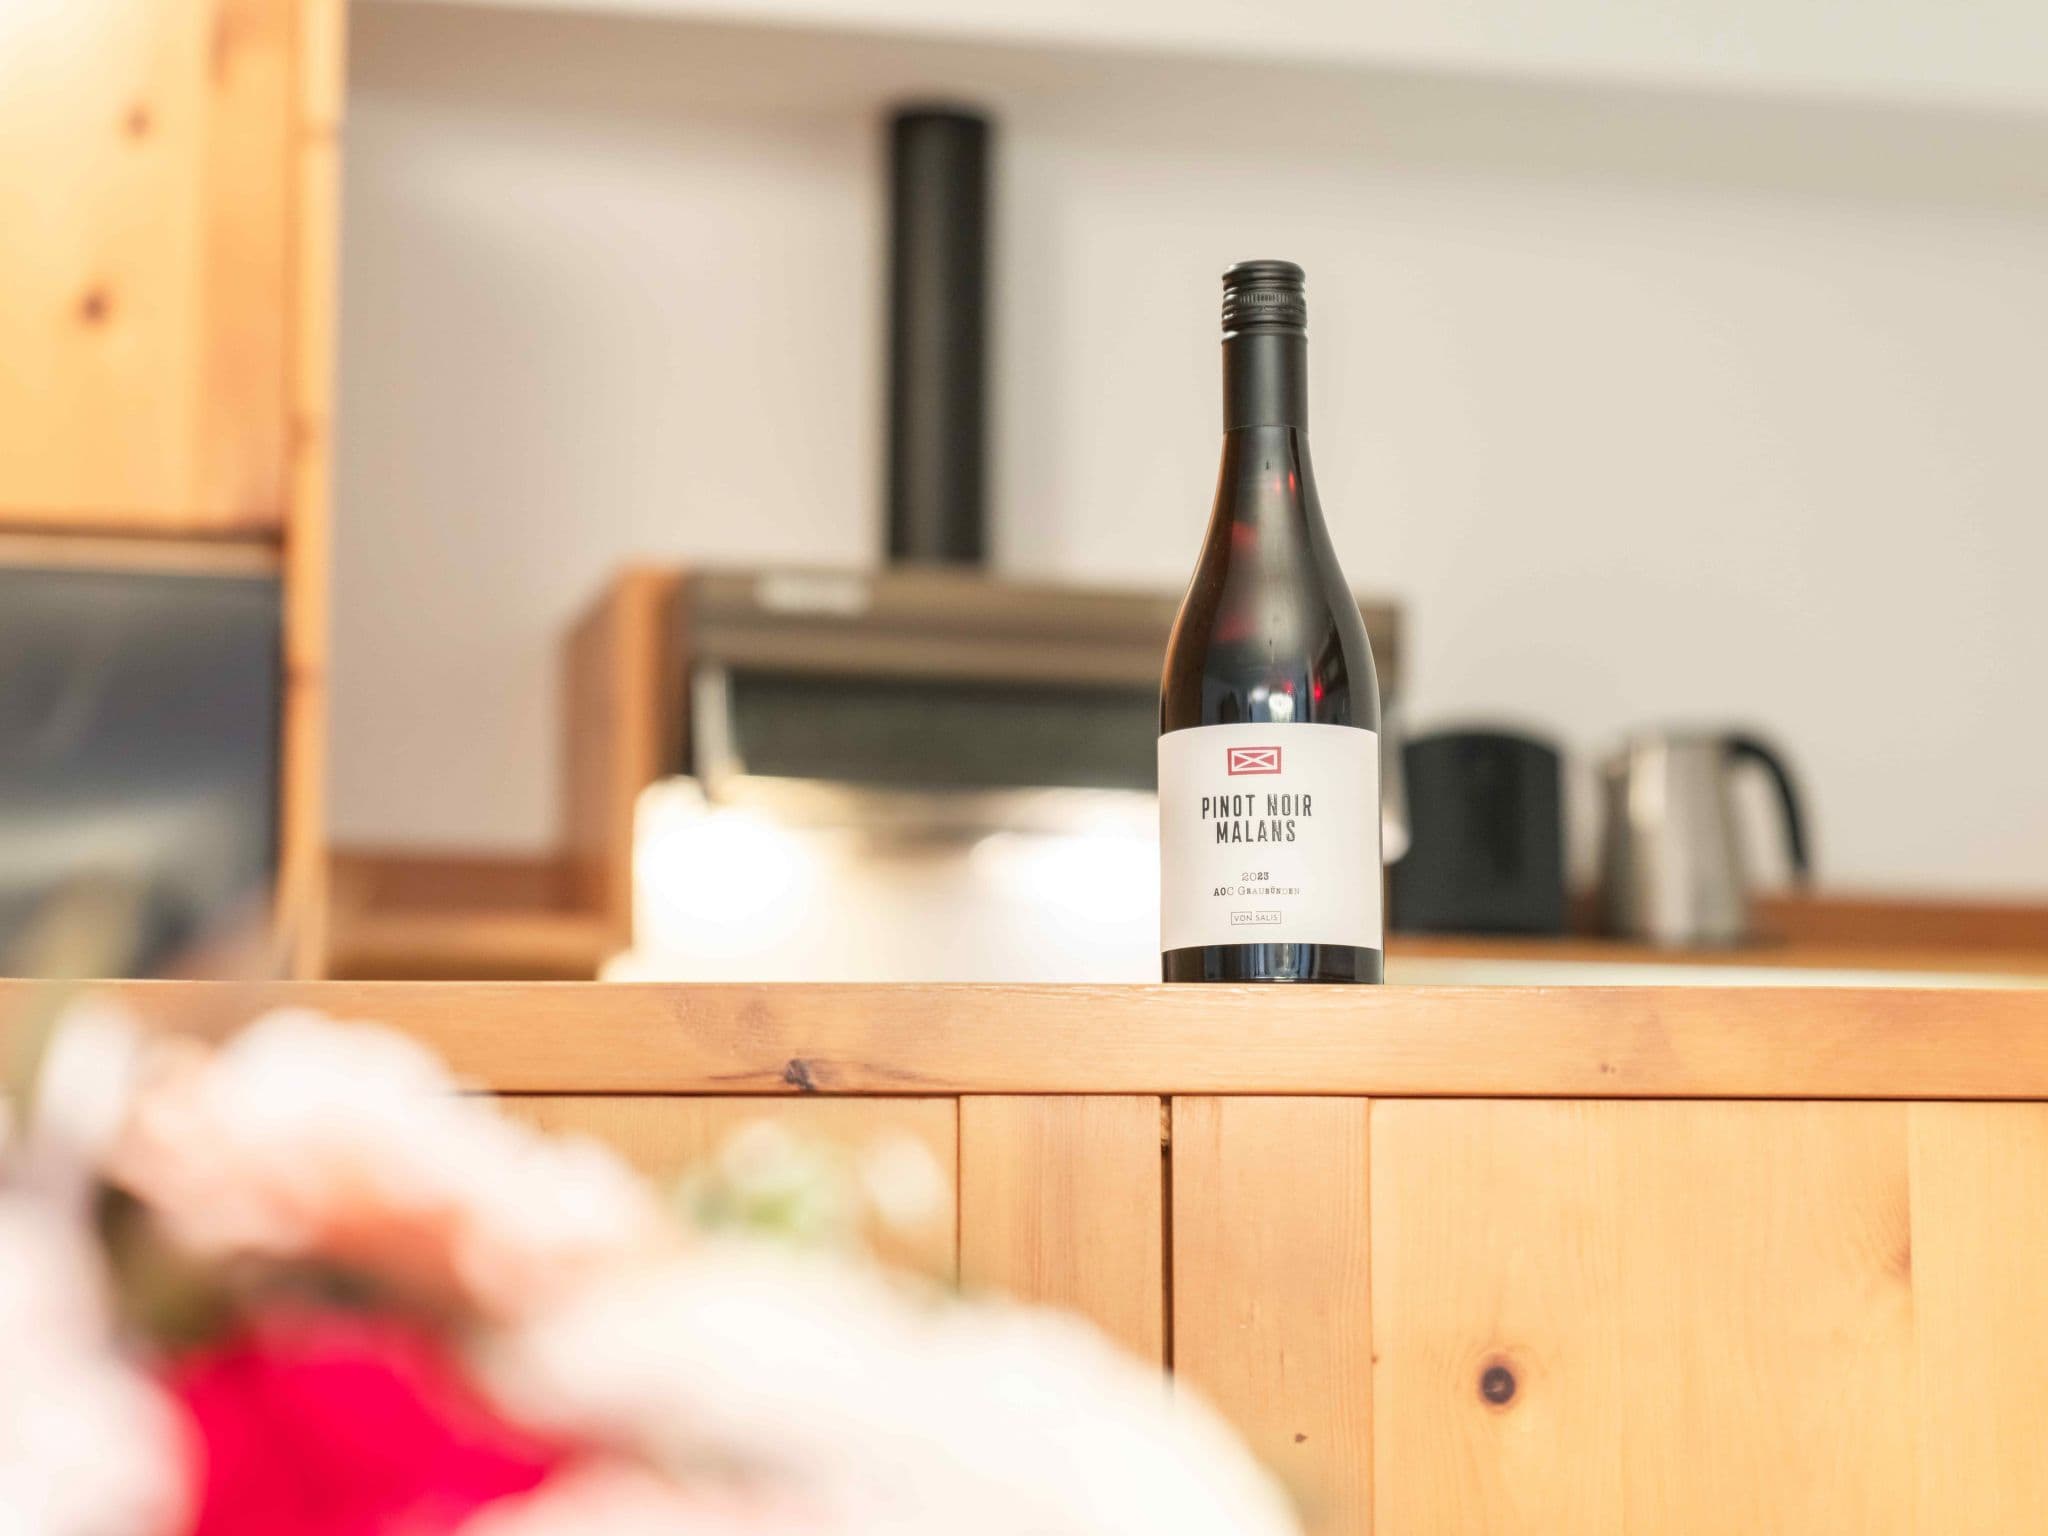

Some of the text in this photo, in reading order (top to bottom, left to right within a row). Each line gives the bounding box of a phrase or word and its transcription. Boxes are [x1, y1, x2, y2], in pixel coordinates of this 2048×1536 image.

[1202, 794, 1312, 820] PINOT NOIR
[1216, 819, 1296, 844] MALANS
[1241, 871, 1270, 882] 2023
[1213, 886, 1234, 897] AOC
[1233, 913, 1278, 922] VON SALIS
